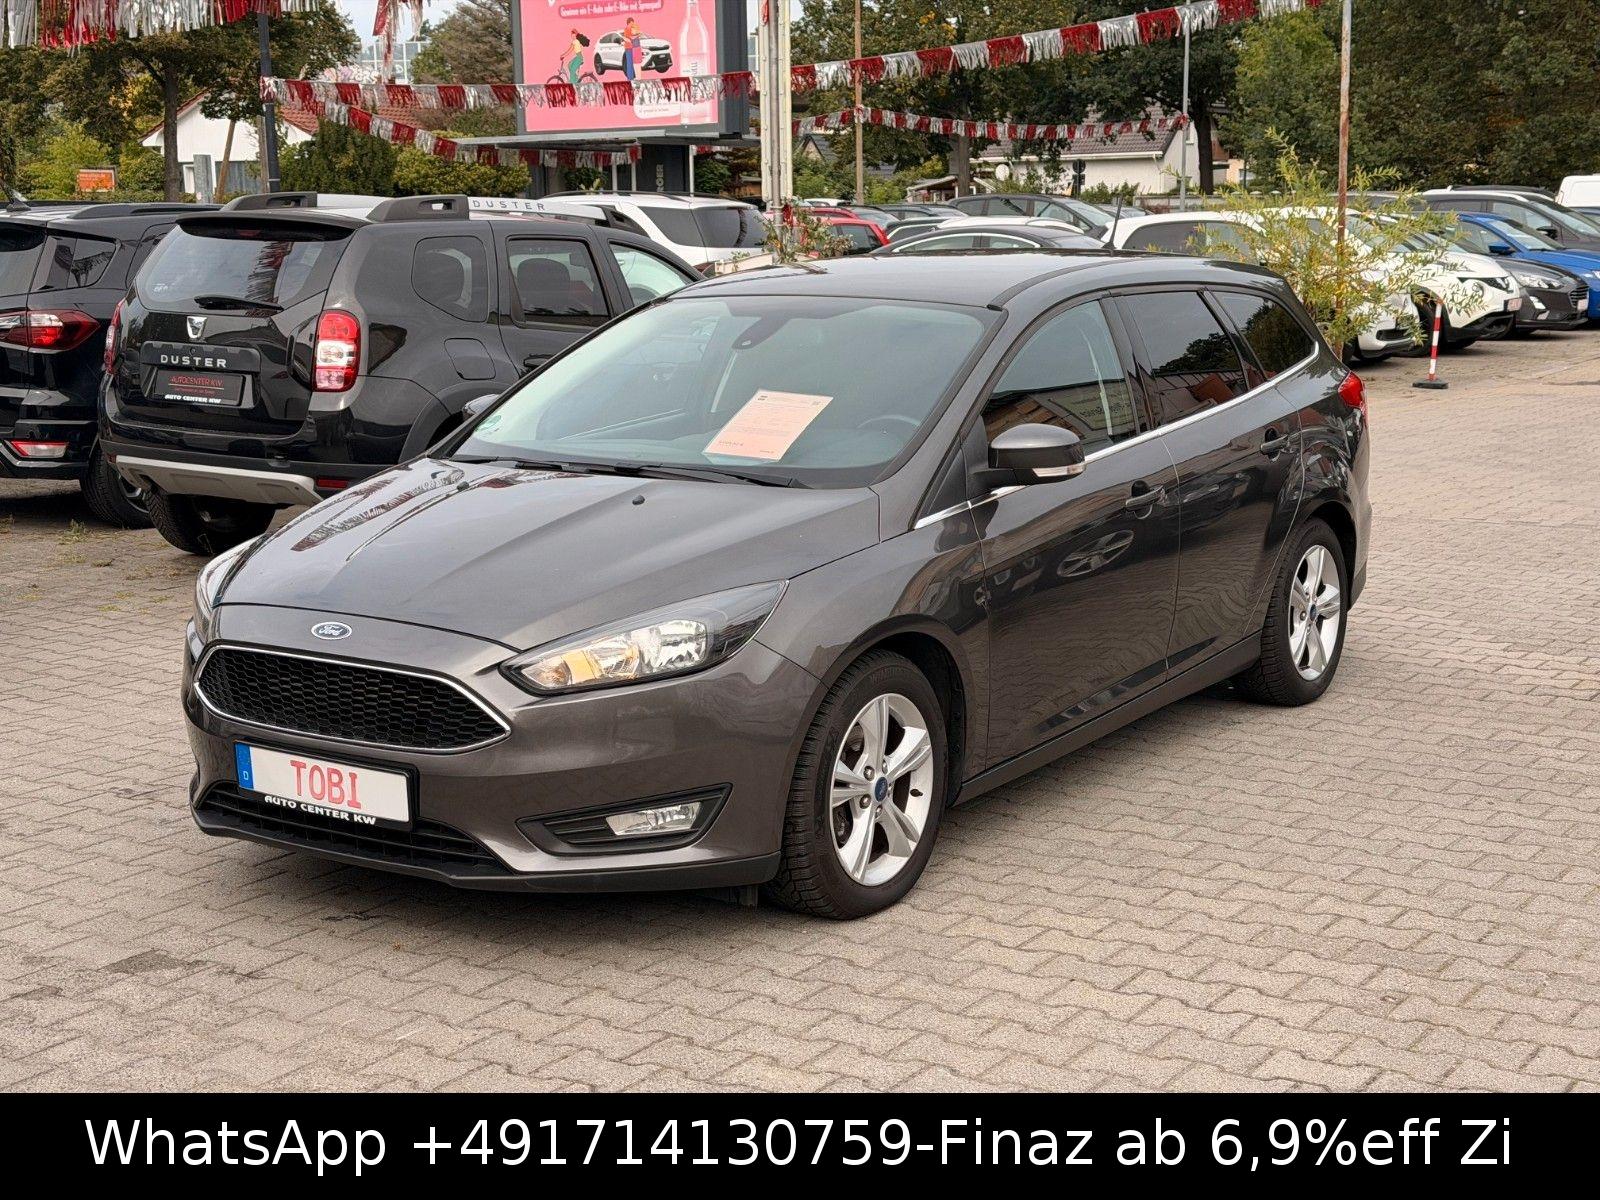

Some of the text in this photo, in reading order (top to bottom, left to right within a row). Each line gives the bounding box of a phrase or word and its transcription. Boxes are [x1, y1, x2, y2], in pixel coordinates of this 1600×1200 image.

[473, 200, 545, 210] DUSTER
[161, 354, 227, 368] DUSTER
[318, 625, 344, 636] Ford
[243, 770, 249, 780] D
[290, 759, 362, 810] TOBI
[264, 794, 377, 826] AUTO CENTER KW
